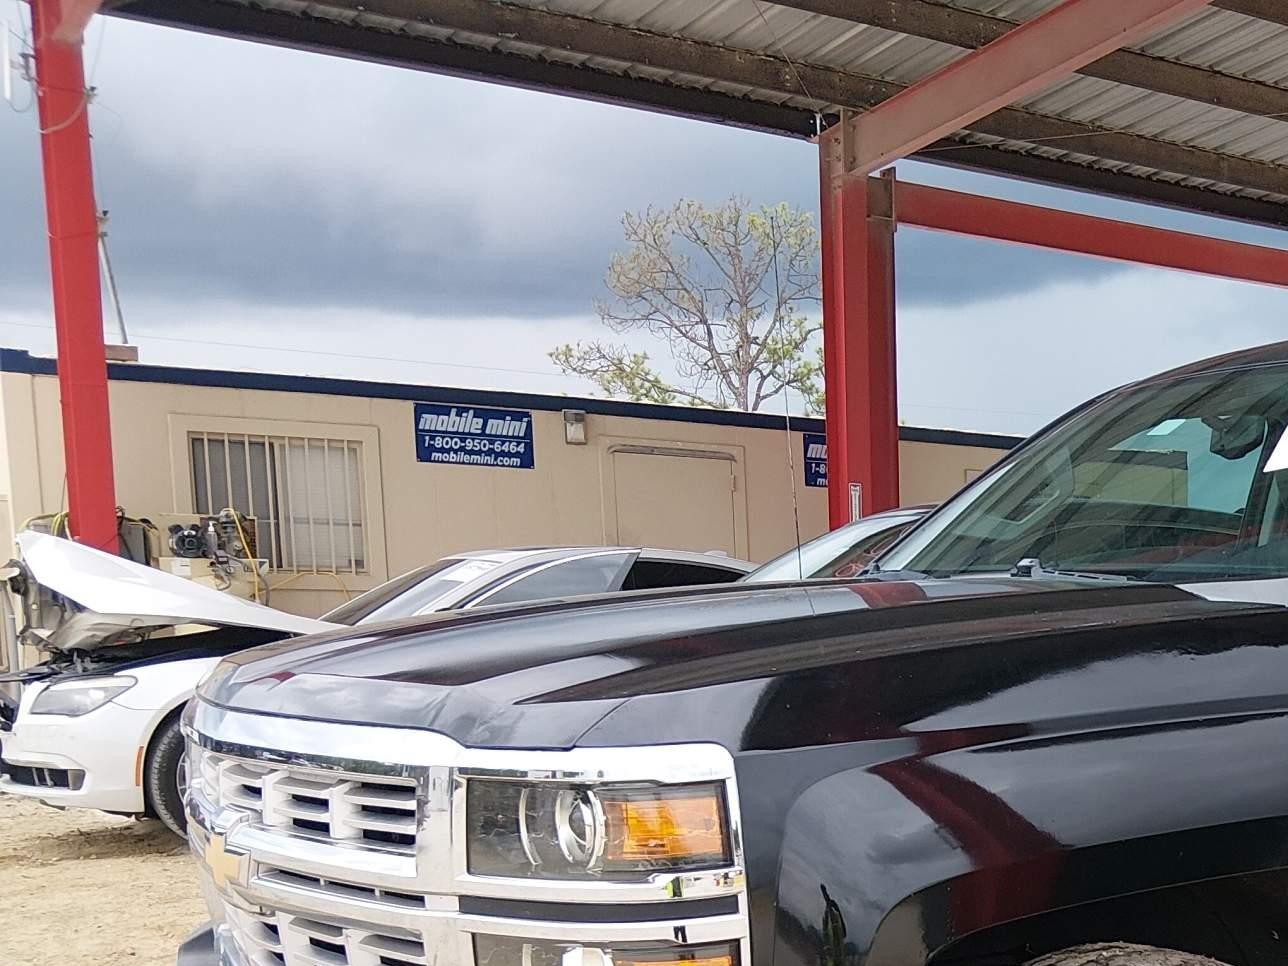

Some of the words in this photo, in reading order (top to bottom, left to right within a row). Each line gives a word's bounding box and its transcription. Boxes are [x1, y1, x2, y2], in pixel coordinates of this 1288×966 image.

[419, 408, 484, 434] mobile
[485, 416, 531, 437] mini
[424, 436, 525, 454] 1-800-950-6464
[431, 452, 521, 466] mobilemini.com
